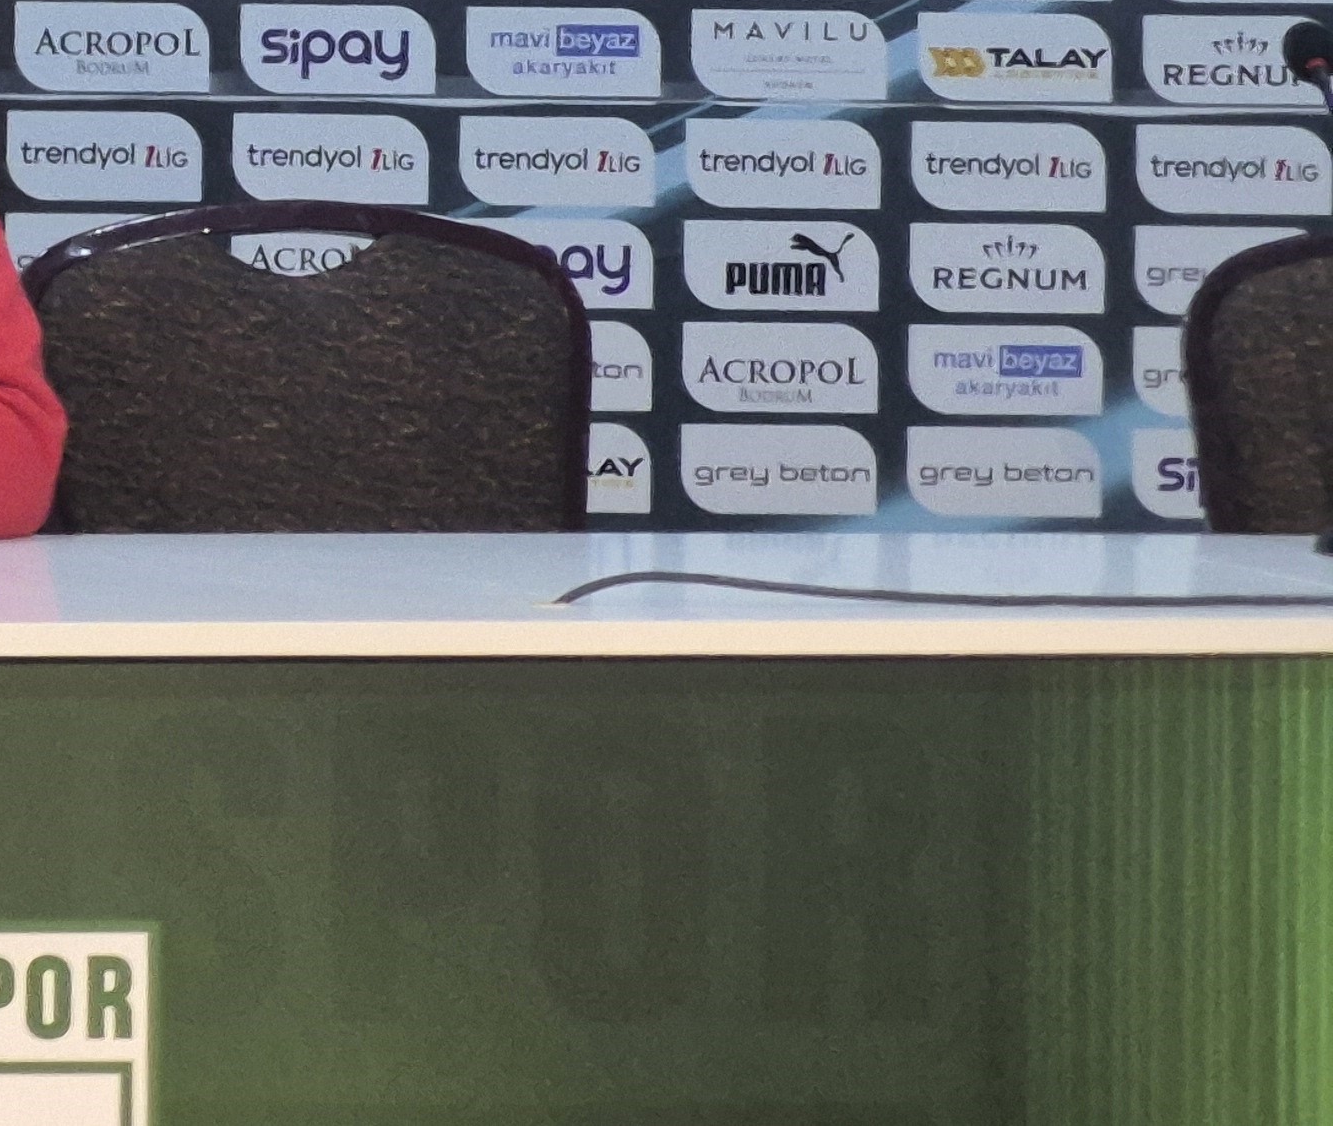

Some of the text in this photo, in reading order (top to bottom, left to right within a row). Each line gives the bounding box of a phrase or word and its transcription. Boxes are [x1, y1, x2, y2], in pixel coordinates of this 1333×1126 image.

[35, 29, 200, 56] ACROPOL
[261, 29, 409, 81] sipay
[490, 29, 636, 55] mavi beyaz
[987, 48, 1108, 68] TALAY
[1163, 65, 1298, 86] REGNU
[21, 142, 135, 169] trendyol
[247, 145, 361, 172] trendyol
[475, 148, 588, 174] trendyol
[700, 149, 814, 177] trendyol
[926, 153, 1040, 179] trendyol
[1151, 155, 1266, 182] trendyol
[251, 245, 357, 272] ACRO
[726, 262, 826, 295] PUMA
[933, 267, 1086, 290] REGNUM
[1147, 267, 1202, 286] gre
[591, 361, 644, 380] ton
[699, 357, 863, 384] ACROPOL
[934, 348, 1078, 375] mavi beyaz
[694, 463, 870, 487] grey beton
[919, 463, 1095, 487] grey beton
